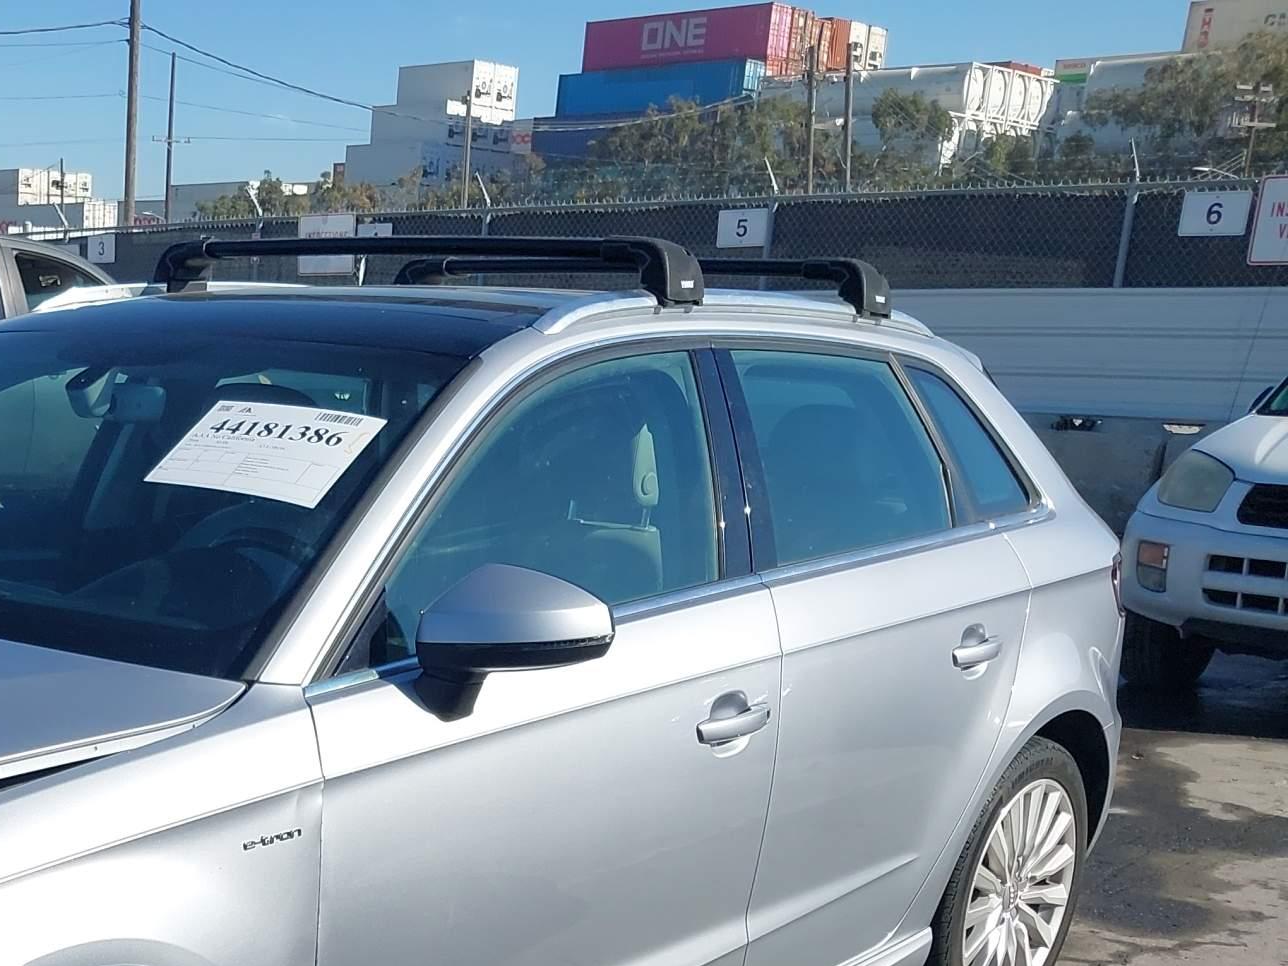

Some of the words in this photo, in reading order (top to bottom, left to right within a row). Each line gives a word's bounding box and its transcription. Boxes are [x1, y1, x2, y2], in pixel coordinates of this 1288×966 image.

[641, 17, 707, 51] ONE
[1205, 202, 1224, 226] 6
[735, 218, 749, 238] 5
[98, 240, 105, 256] 3
[210, 418, 350, 447] 44181386
[243, 828, 302, 851] e-tron
